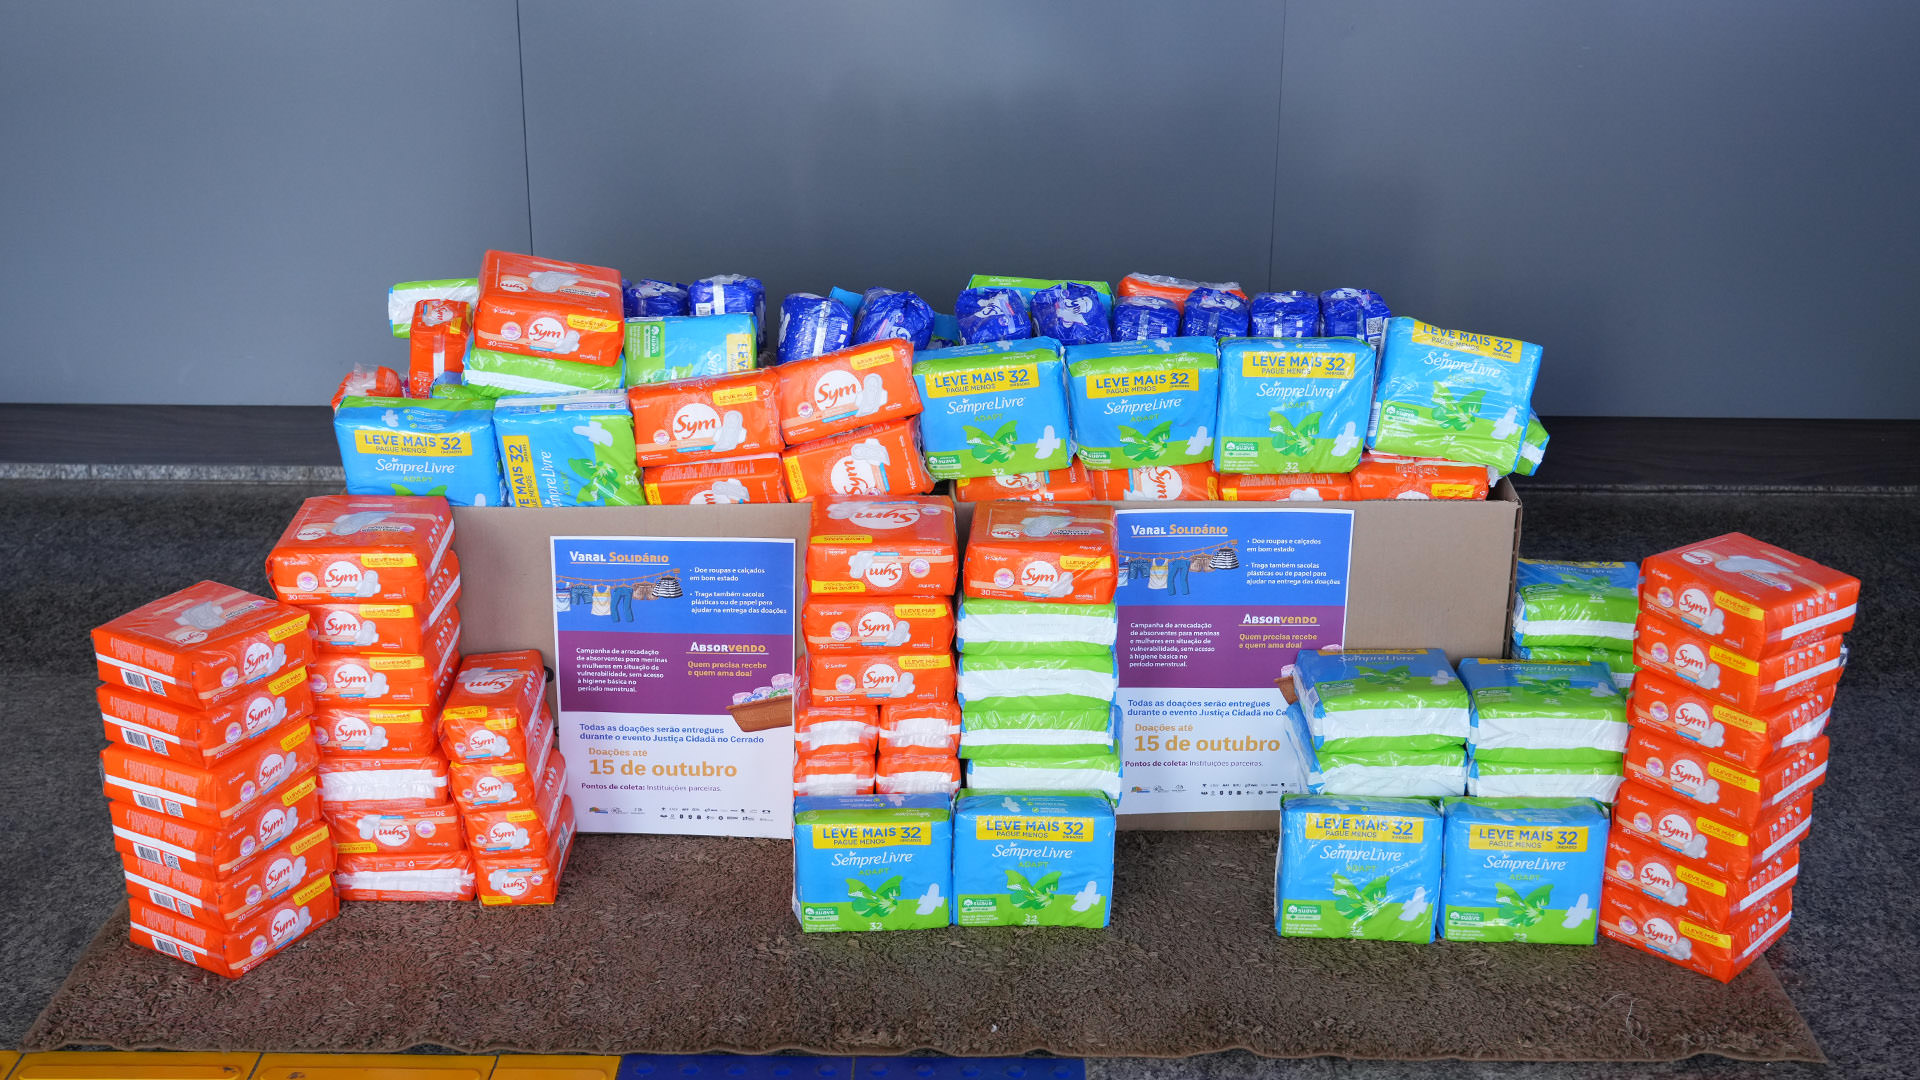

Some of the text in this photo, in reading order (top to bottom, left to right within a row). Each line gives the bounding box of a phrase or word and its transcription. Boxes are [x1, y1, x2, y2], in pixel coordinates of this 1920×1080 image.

[528, 324, 562, 340] Sym
[1423, 325, 1512, 354] LEVE MAIS 32
[1252, 356, 1346, 371] LEVE MAIS 32
[1261, 367, 1311, 376] PAGUE MENOS
[934, 368, 1029, 388] LEVE MAIS 32
[1096, 372, 1189, 389] LEVE MAIS 32
[816, 380, 857, 404] Sym
[970, 384, 996, 392] MENOS
[675, 415, 716, 439] Sym
[364, 434, 462, 450] LEVE MAIS 32
[401, 446, 426, 454] MENOS
[326, 569, 359, 587] Sym
[737, 567, 765, 575] calçados
[1025, 568, 1055, 587] Sym
[740, 599, 757, 607] papel
[1679, 594, 1708, 616] Sym
[761, 608, 787, 616] doações
[326, 618, 358, 633] Sym
[860, 619, 891, 637] Sym
[245, 650, 270, 671] Sym
[624, 663, 649, 672] situação
[688, 661, 767, 670] Quem precisa recebe
[1675, 650, 1704, 670] Sym
[335, 671, 367, 686] Sym
[694, 670, 714, 678] quem
[734, 669, 752, 677] doa!
[864, 671, 895, 688] Sym
[248, 703, 271, 726] Sym
[1676, 708, 1707, 727] Sym
[335, 724, 367, 740] Sym
[580, 723, 605, 732] Todas
[618, 725, 655, 734] doações
[656, 725, 679, 733] serão
[682, 726, 724, 735] entregues
[470, 737, 495, 748] Sym
[580, 732, 613, 741] durante
[653, 734, 684, 743] Justiça
[686, 735, 716, 743] Cidadã
[1134, 735, 1281, 751] 15 de outubro
[588, 747, 648, 758] Doações até
[589, 760, 737, 777] 15 de outubro
[1671, 764, 1701, 784] Sym
[478, 782, 502, 795] Sym
[647, 784, 687, 792] Instituições
[689, 785, 721, 793] parceiras.
[261, 815, 283, 837] Sym
[823, 826, 921, 839] LEVE MAIS 32
[986, 820, 1084, 836] LEVE MAIS 32
[1315, 818, 1414, 836] LEVE MAIS 32
[1325, 830, 1349, 838] PAGUE
[1659, 820, 1690, 840] Sym
[490, 829, 516, 841] Sym
[859, 837, 885, 845] MENOS
[1023, 831, 1048, 839] MENOS
[1479, 828, 1578, 845] LEVE MAIS 32
[1488, 840, 1513, 848] PAGUE
[266, 864, 291, 886] Sym
[1641, 868, 1671, 887] Sym
[272, 917, 297, 937] Sym
[1643, 923, 1675, 943] Sym
